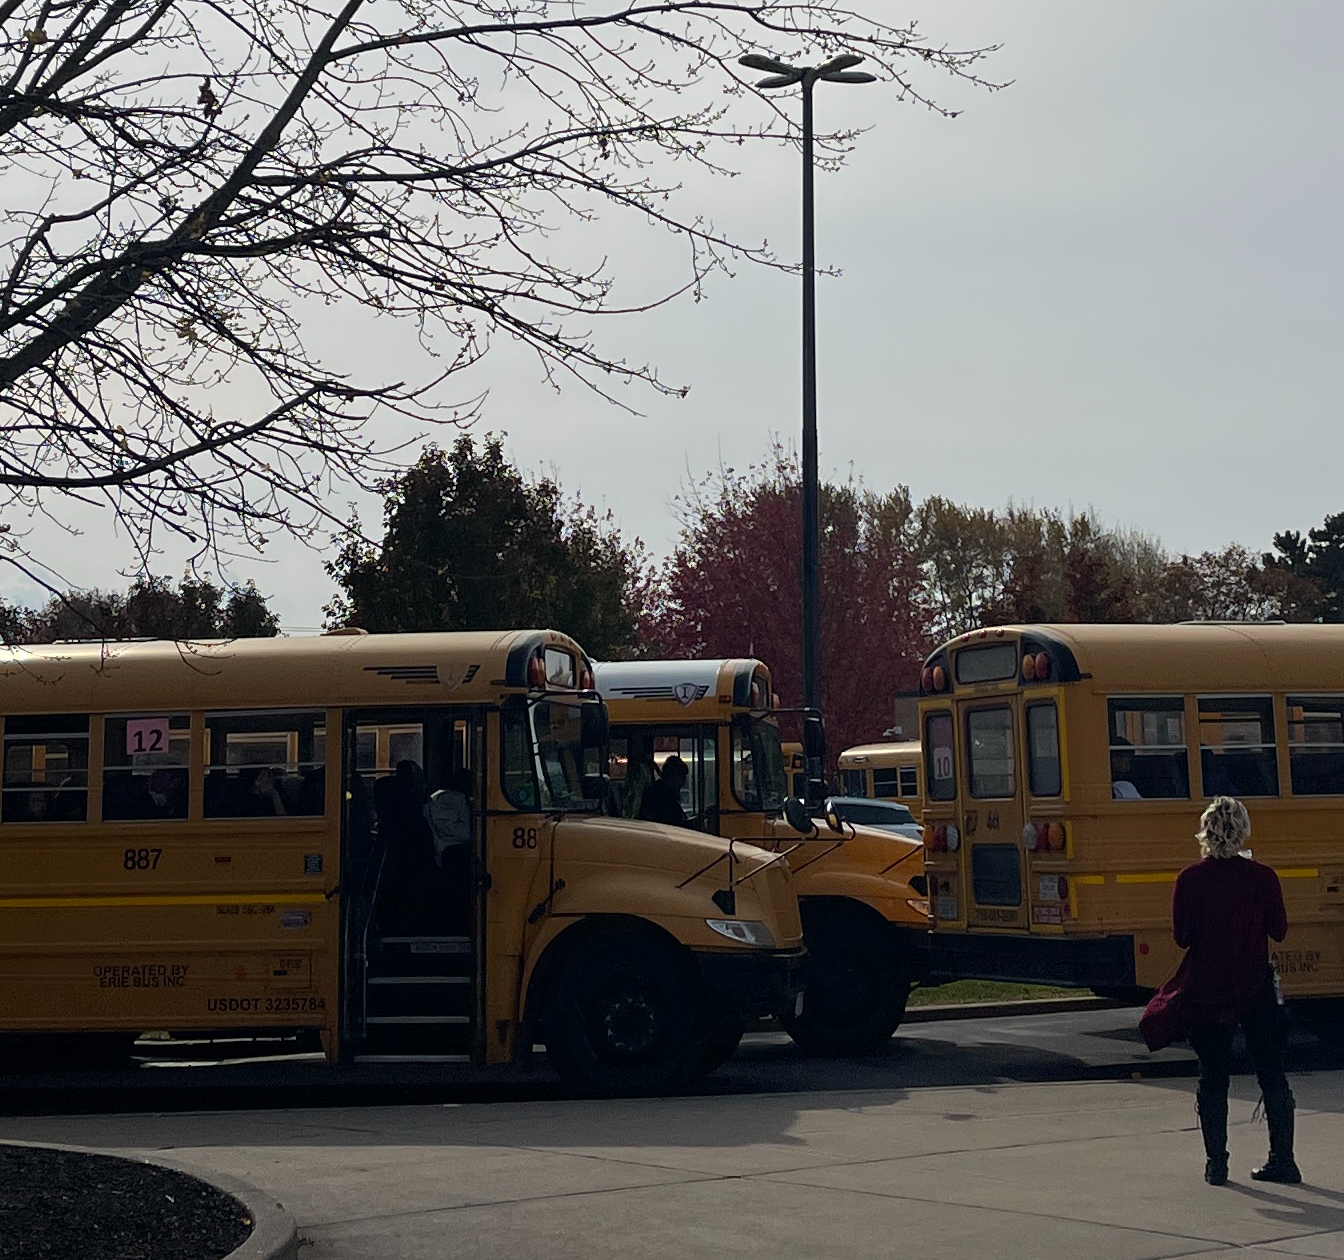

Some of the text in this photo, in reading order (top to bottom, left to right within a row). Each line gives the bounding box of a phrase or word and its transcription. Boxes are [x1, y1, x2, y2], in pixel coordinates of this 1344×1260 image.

[133, 728, 163, 753] 12
[936, 756, 951, 778] 10
[123, 848, 163, 870] 887
[1305, 950, 1321, 961] BY
[93, 964, 189, 977] OPERATED BY
[1299, 962, 1318, 973] INC
[100, 976, 185, 988] ERIE BUS INC
[207, 997, 325, 1011] USDOT 3235784
